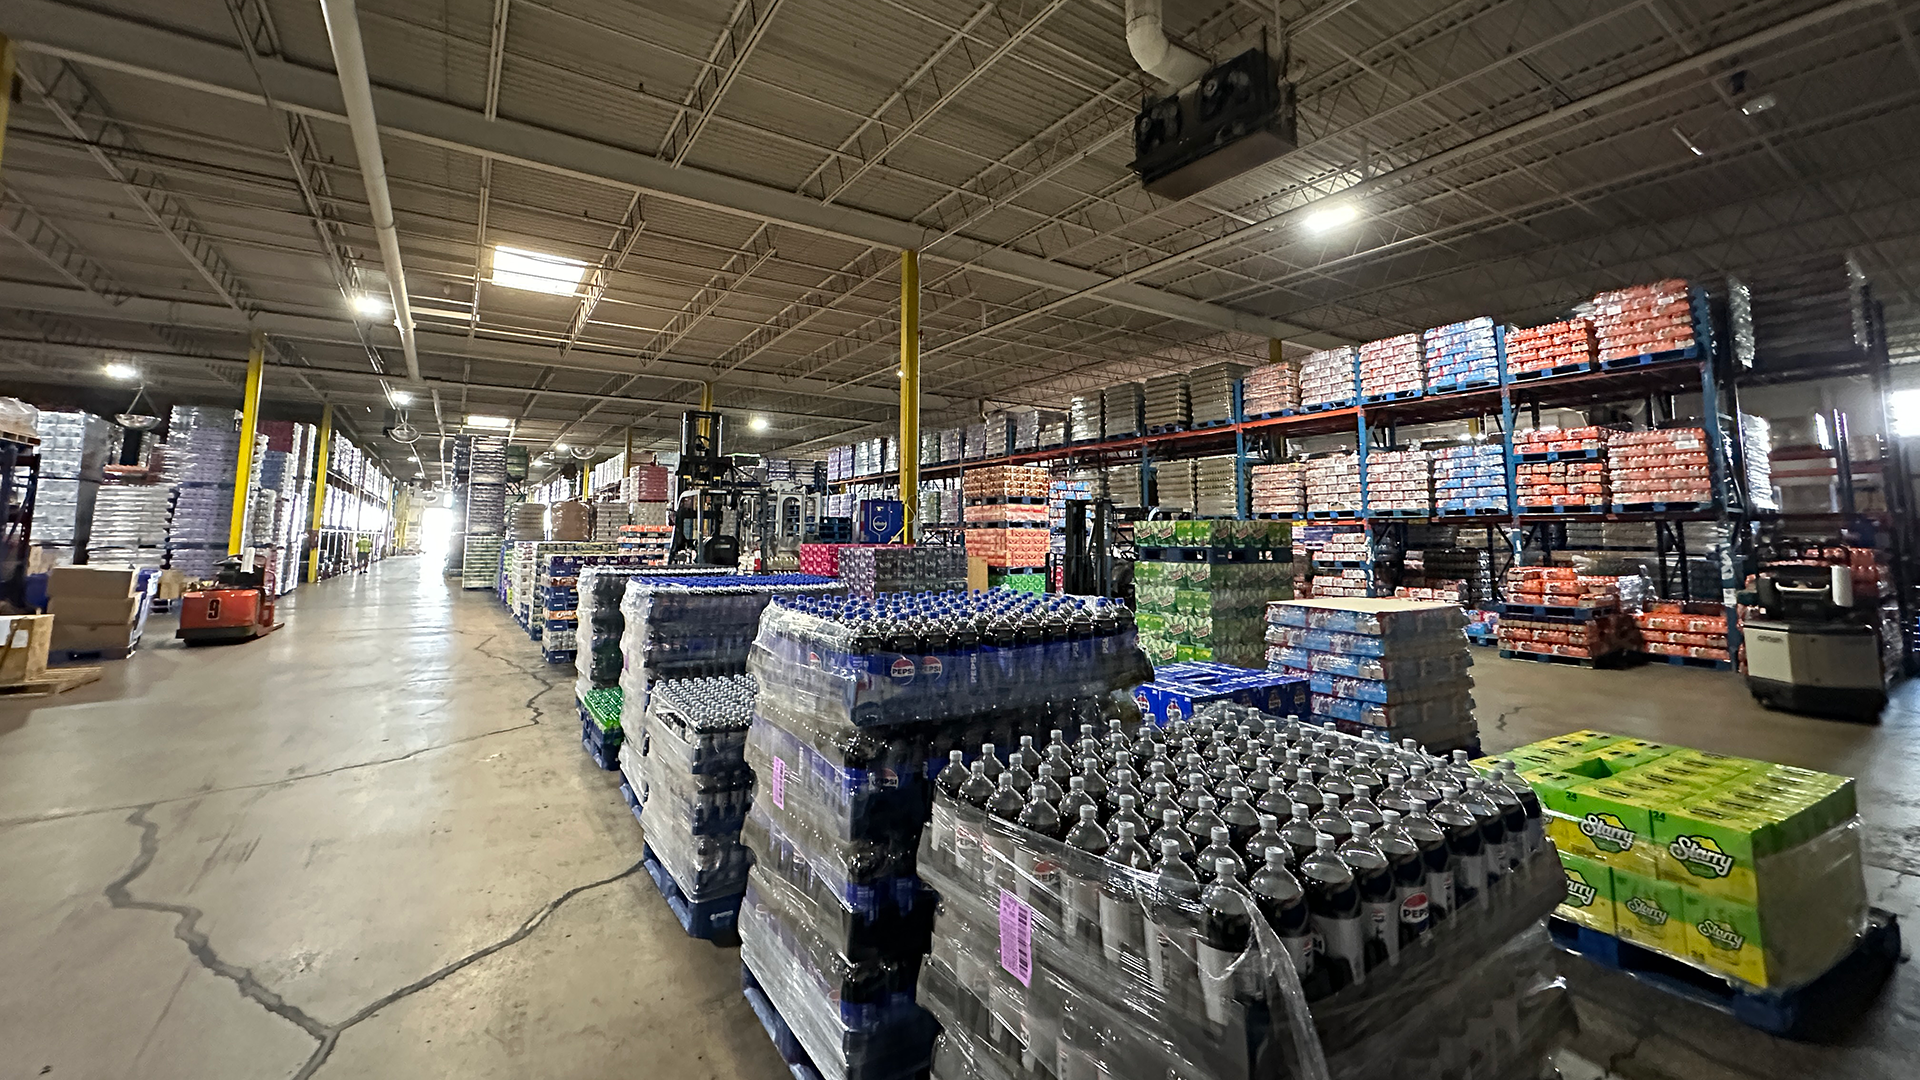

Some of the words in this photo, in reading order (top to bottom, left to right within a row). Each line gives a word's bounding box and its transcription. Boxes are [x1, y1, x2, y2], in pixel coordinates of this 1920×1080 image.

[208, 599, 220, 619] 9
[892, 668, 914, 676] PEPSI
[1566, 791, 1577, 800] 24
[1653, 811, 1666, 820] 24
[1580, 813, 1635, 850] Starry
[1669, 836, 1733, 876] Starry
[1565, 879, 1596, 905] arry
[1403, 908, 1429, 918] PEP
[1627, 898, 1667, 926] Starry
[1698, 920, 1744, 949] Starry
